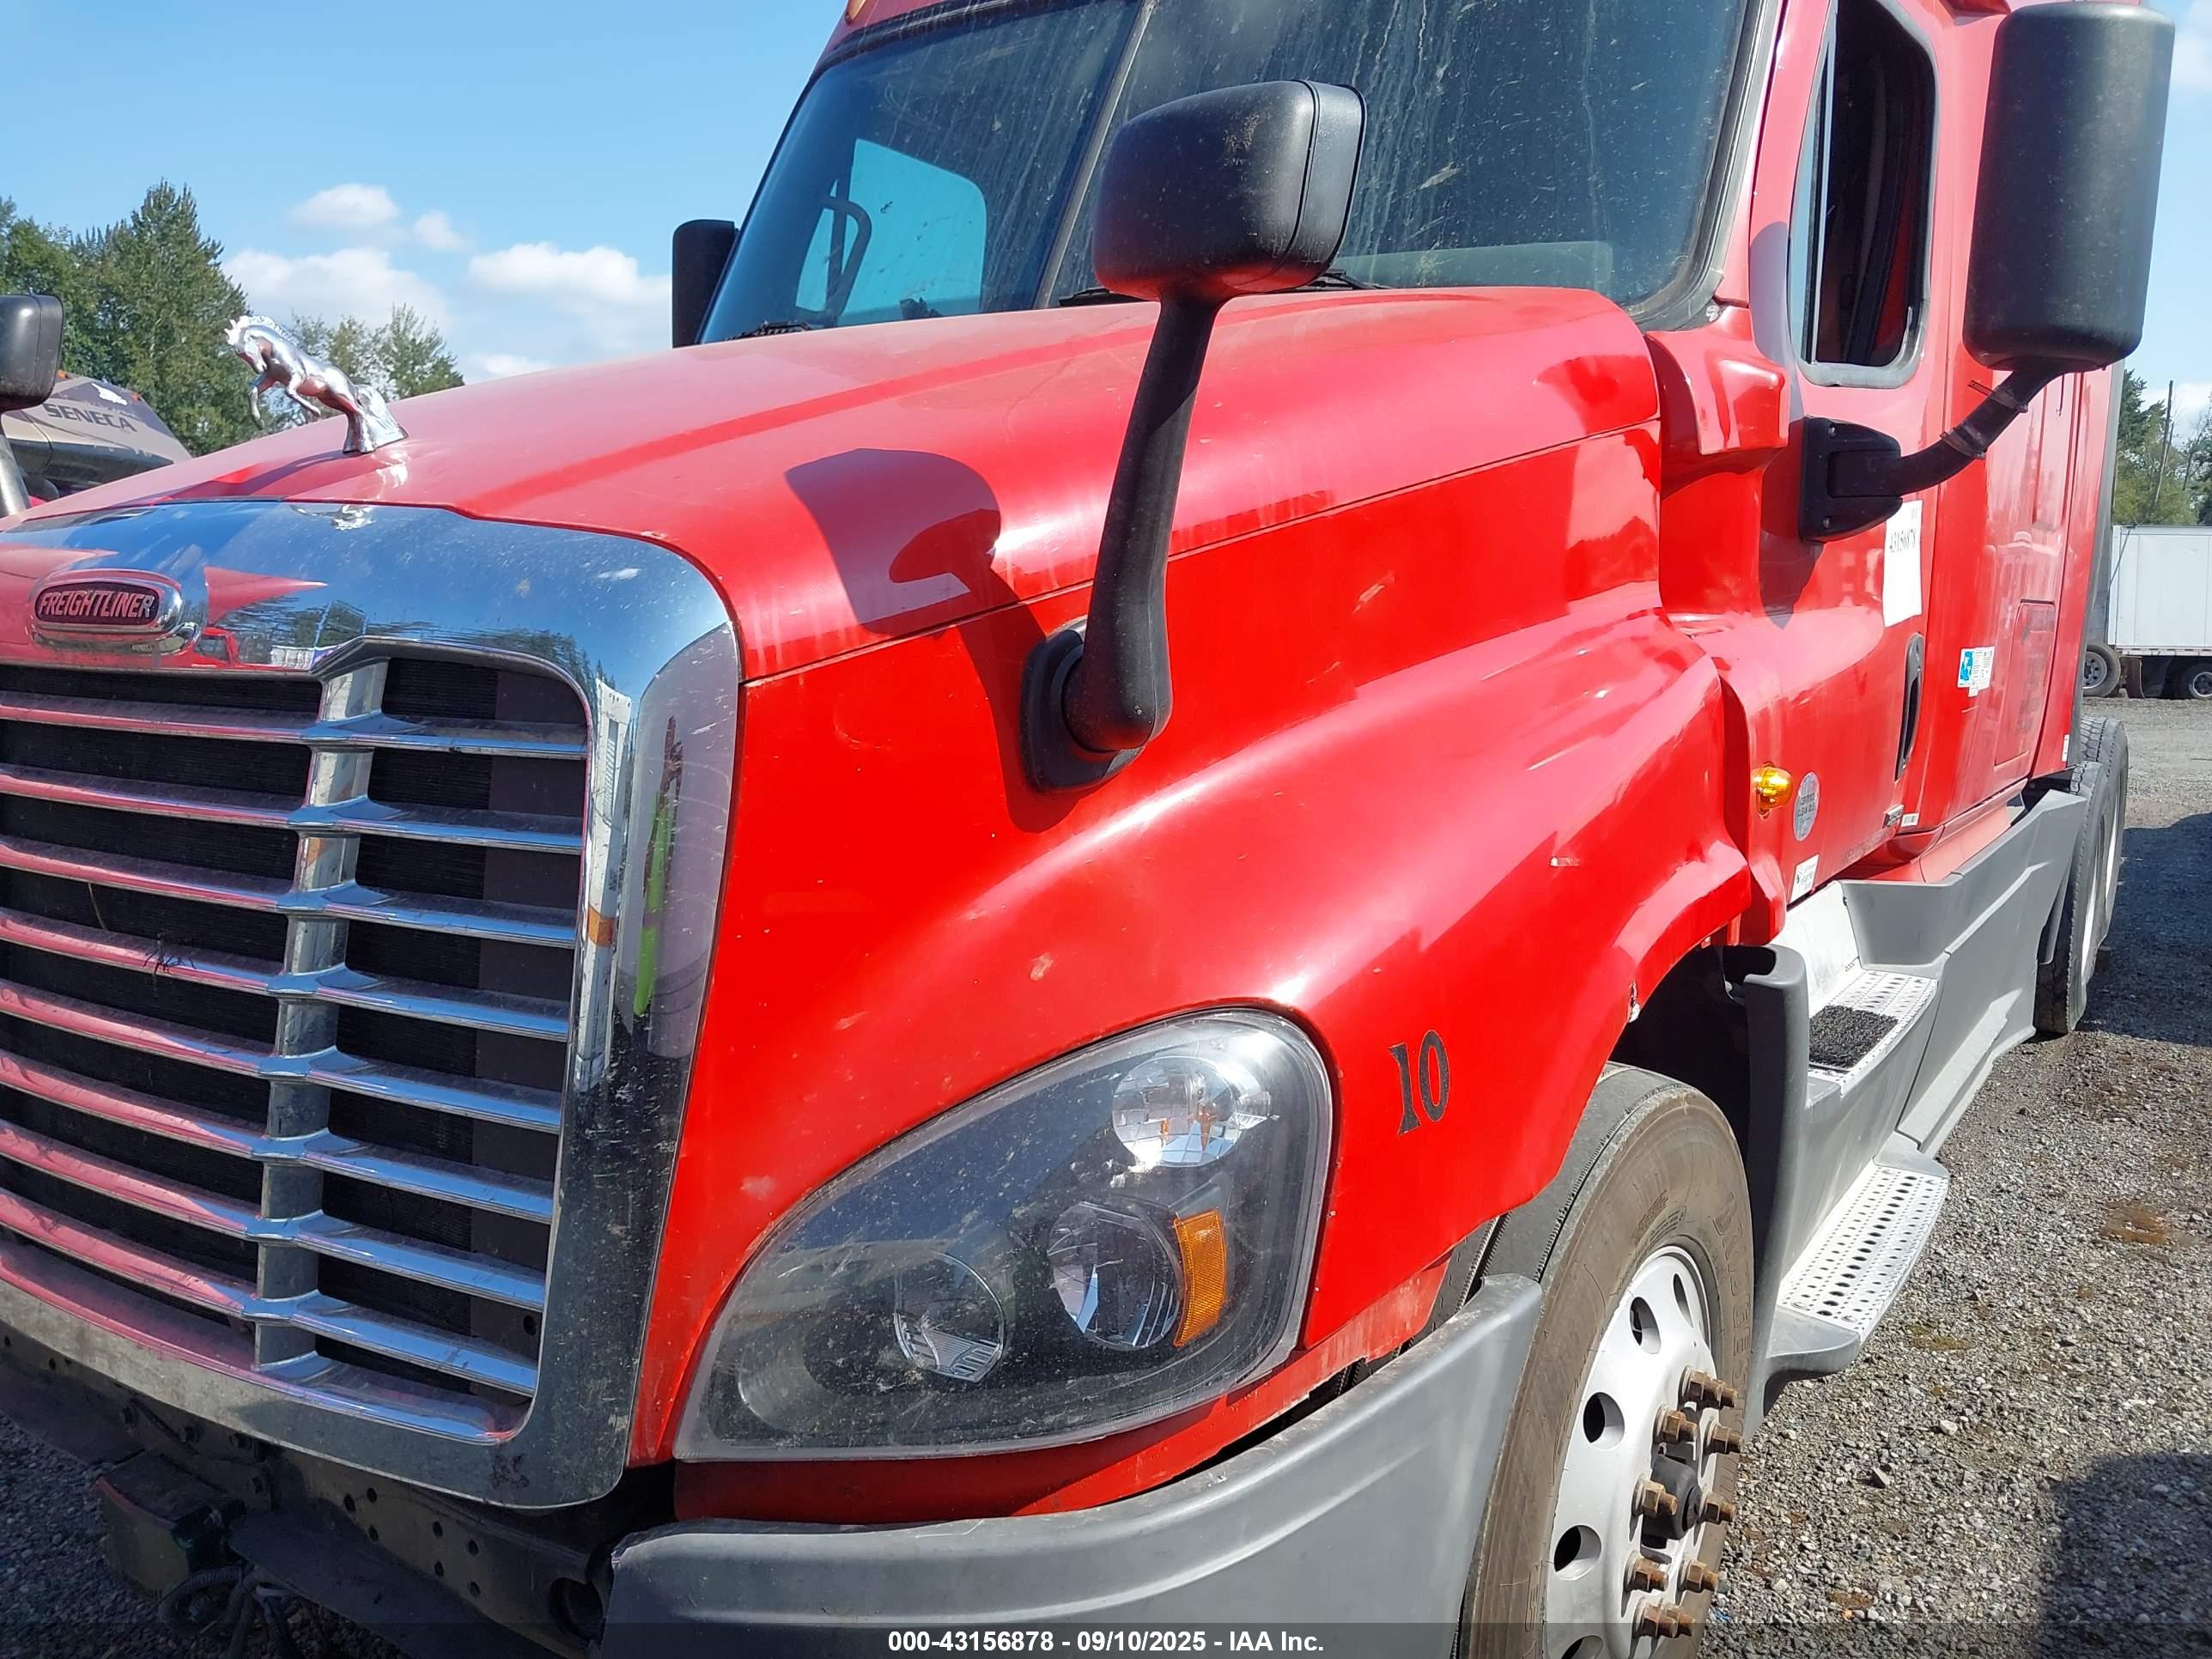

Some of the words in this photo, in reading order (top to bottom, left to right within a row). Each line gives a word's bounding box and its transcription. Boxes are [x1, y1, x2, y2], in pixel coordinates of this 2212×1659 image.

[42, 404, 138, 433] SENECA
[38, 590, 155, 619] FREIGHTLINER
[1387, 1029, 1451, 1136] 10
